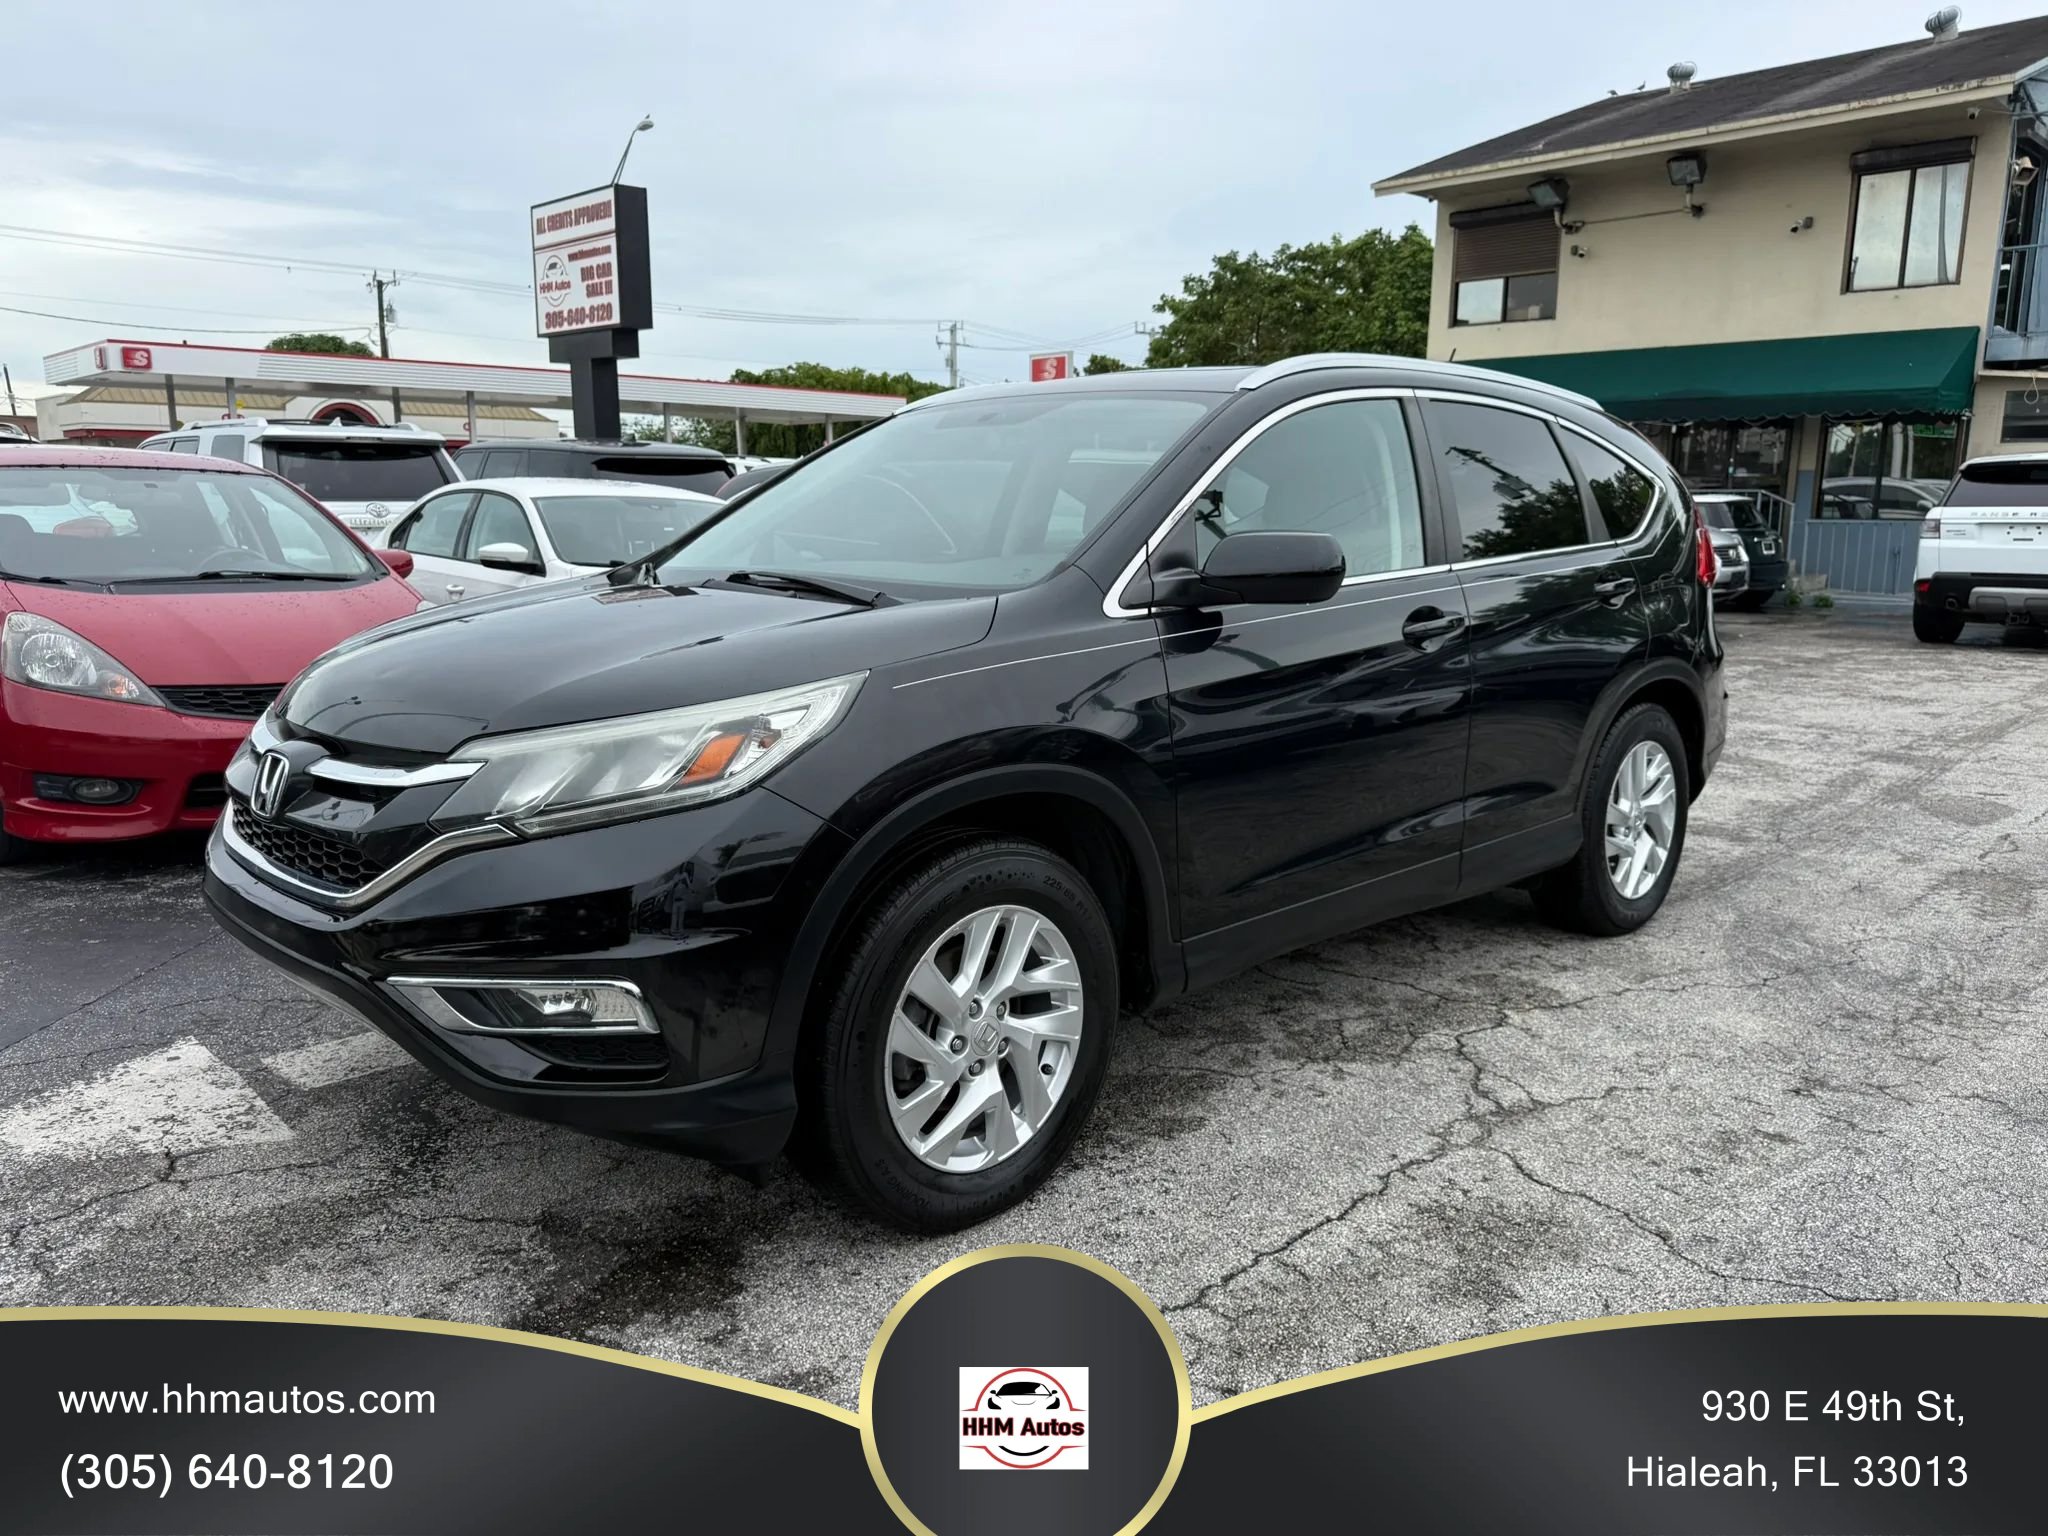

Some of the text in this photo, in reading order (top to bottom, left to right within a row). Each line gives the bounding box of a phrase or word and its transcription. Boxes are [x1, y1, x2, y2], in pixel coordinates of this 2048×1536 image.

[536, 216, 547, 235] ALL
[547, 209, 573, 232] CREDITS
[580, 261, 612, 282] BIG CAR
[585, 281, 604, 298] SALE
[545, 302, 613, 329] 305-640-8120
